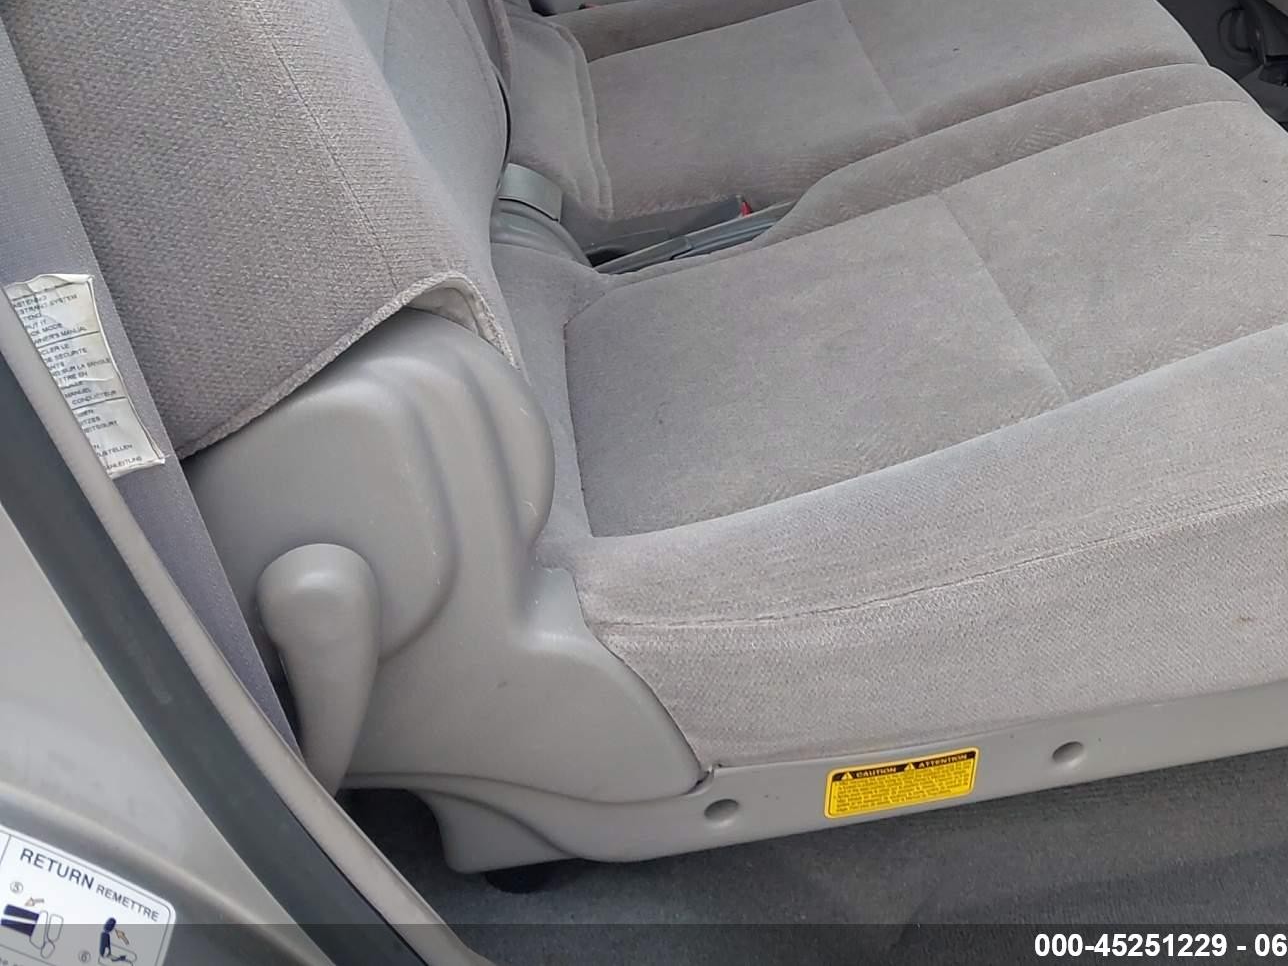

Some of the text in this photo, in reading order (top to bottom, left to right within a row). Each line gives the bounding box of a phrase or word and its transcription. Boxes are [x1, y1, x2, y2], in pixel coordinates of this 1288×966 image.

[855, 754, 968, 778] CAUTION ATTENTION
[19, 847, 159, 922] RETURN REMETTRE
